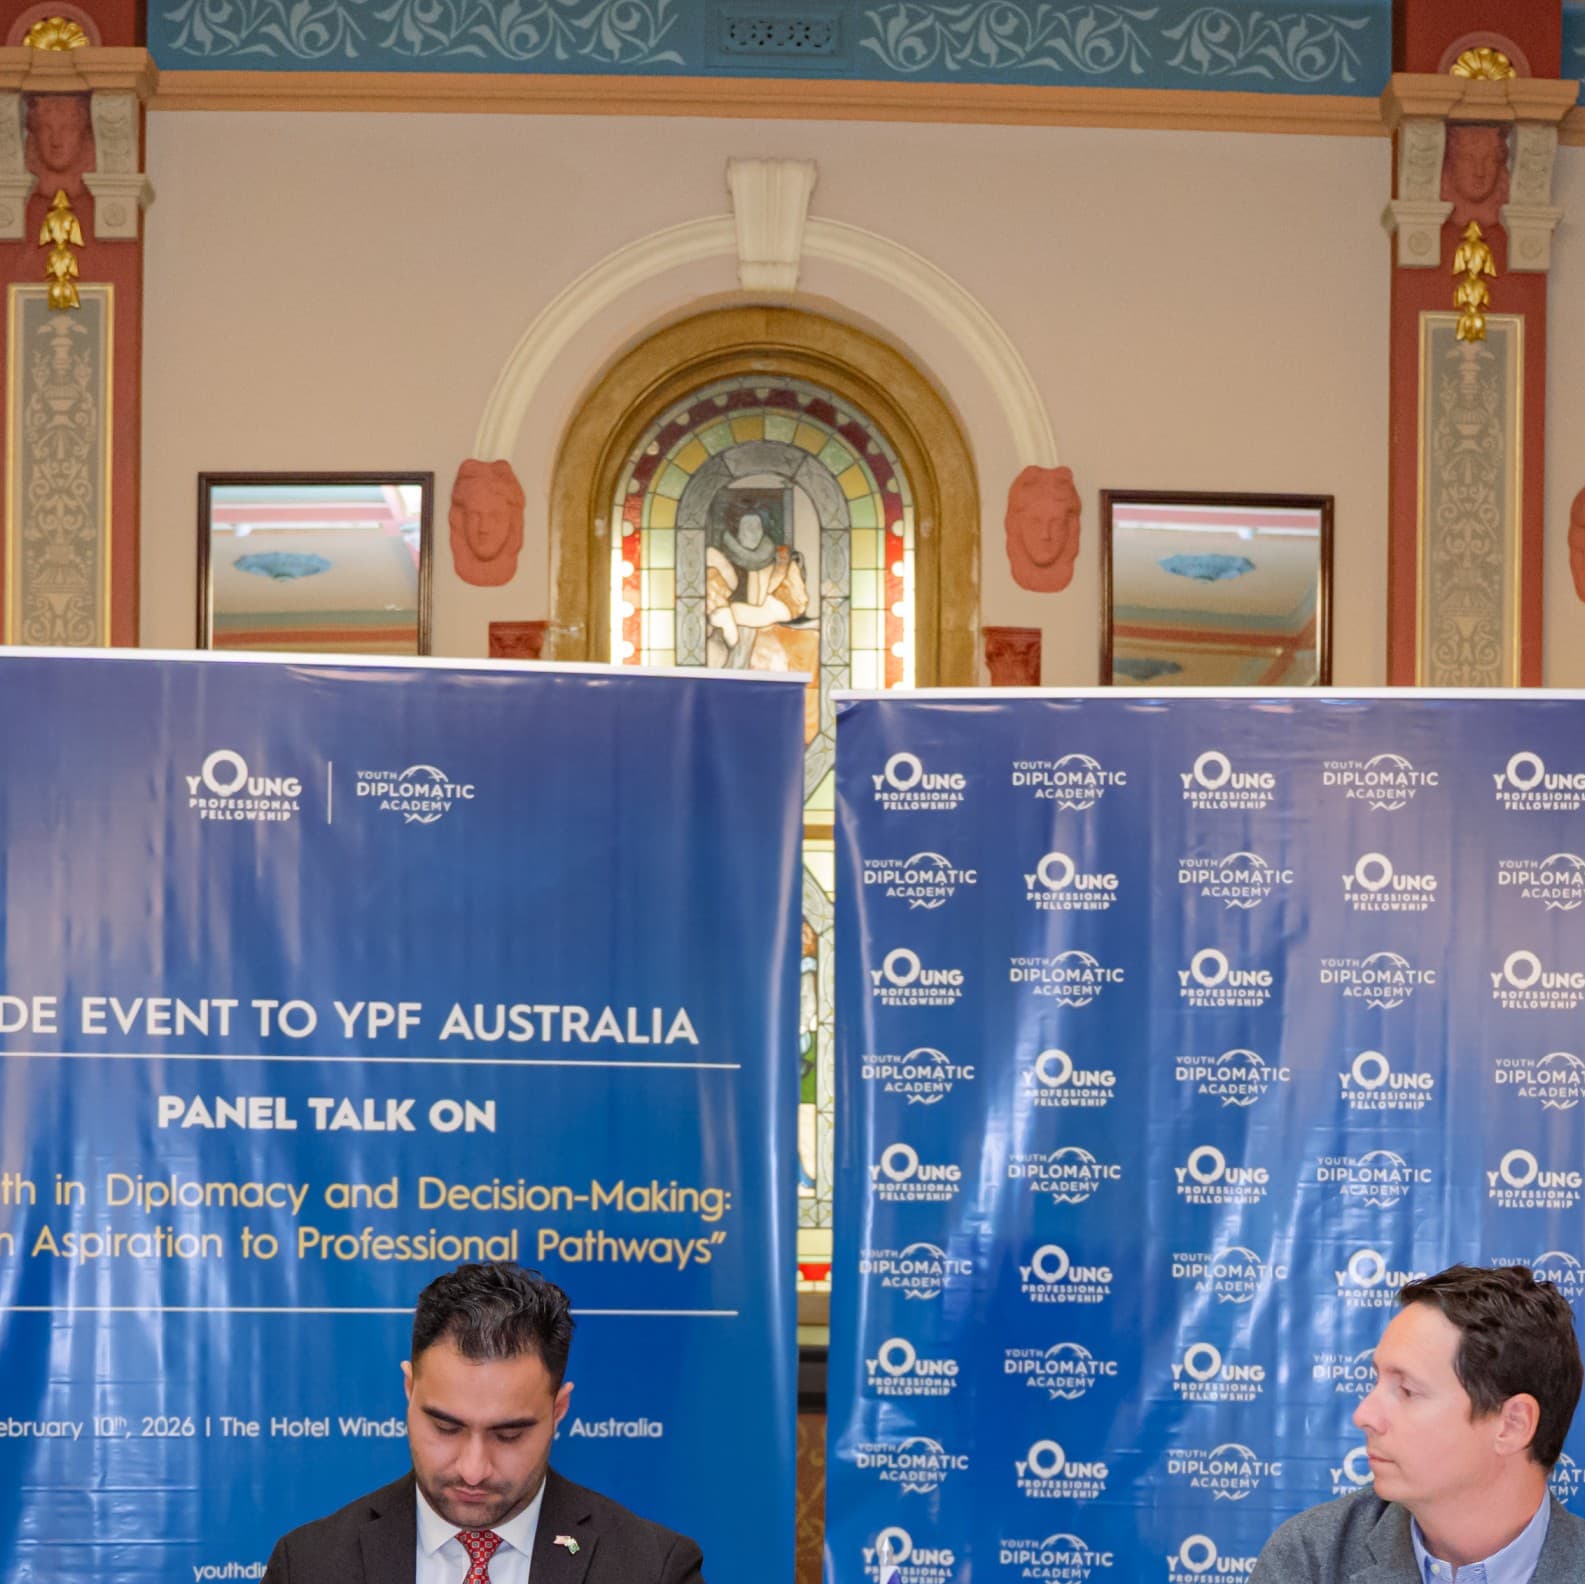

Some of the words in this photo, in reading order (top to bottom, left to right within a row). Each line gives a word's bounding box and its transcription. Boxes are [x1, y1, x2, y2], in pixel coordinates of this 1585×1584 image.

[872, 752, 966, 790] YOUNG
[1012, 760, 1052, 770] YOUTH
[1182, 751, 1276, 790] YOUNG
[1323, 760, 1363, 770] YOUTH
[185, 749, 302, 797] YOUNG
[357, 771, 398, 780] YOUTH
[1012, 770, 1127, 786] DIPLOMATIC
[1323, 770, 1438, 786] DIPLOMATIC
[356, 782, 475, 799] DIPLOMATIC
[874, 792, 964, 801] PROFESSIONAL
[1035, 788, 1104, 800] ACADEMY
[1183, 792, 1273, 800] PROFESSIONAL
[1346, 788, 1415, 800] ACADEMY
[1496, 792, 1585, 801] PROFESSIONAL
[189, 798, 300, 811] PROFESSIONAL
[380, 800, 452, 812] ACADEMY
[884, 800, 958, 810] FELLOWSHIP
[1192, 800, 1267, 809] FELLOWSHIP
[1506, 800, 1580, 810] FELLOWSHIP
[200, 810, 292, 821] FELLOWSHIP
[863, 858, 903, 868] YOUTH
[863, 868, 978, 884] DIPLOMATIC
[1024, 852, 1118, 890] YOUNG
[886, 886, 955, 898] ACADEMY
[1026, 892, 1116, 901] PROFESSIONAL
[1036, 900, 1110, 910] FELLOWSHIP
[870, 948, 964, 986] YOUNG
[1010, 958, 1050, 968] YOUTH
[1010, 968, 1125, 984] DIPLOMATIC
[872, 988, 962, 997] PROFESSIONAL
[1033, 984, 1102, 996] ACADEMY
[882, 996, 956, 1006] FELLOWSHIP
[81, 996, 239, 1036] EVENT
[251, 999, 318, 1038] TO
[333, 1001, 422, 1040] YPF
[439, 1002, 699, 1045] AUSTRALIA
[1340, 1051, 1434, 1090] YOUNG
[1341, 1092, 1431, 1100] PROFESSIONAL
[1350, 1100, 1425, 1109] FELLOWSHIP
[158, 1095, 297, 1130] PANEL
[307, 1097, 416, 1131] TALK
[428, 1099, 496, 1133] ON
[1176, 1146, 1270, 1184] YOUNG
[1177, 1186, 1267, 1195] PROFESSIONAL
[56, 1173, 85, 1206] in
[106, 1173, 309, 1216] Diplomacy
[324, 1176, 398, 1209] and
[418, 1176, 732, 1222] Decision-Making:
[1186, 1194, 1261, 1204] FELLOWSHIP
[32, 1225, 222, 1265] Aspiration
[241, 1226, 278, 1259] to
[298, 1226, 517, 1261] Professional
[142, 1417, 196, 1437] 2026
[220, 1417, 260, 1437] The
[271, 1417, 330, 1437] Hotel
[340, 1417, 408, 1438] Winds
[569, 1417, 663, 1438] Australia
[1167, 1450, 1207, 1460] YOUTH
[1167, 1460, 1282, 1476] DIPLOMATIC
[1190, 1476, 1259, 1488] ACADEMY
[999, 1540, 1039, 1550] YOUTH
[999, 1550, 1114, 1566] DIPLOMATIC
[1022, 1568, 1091, 1580] ACADEMY
